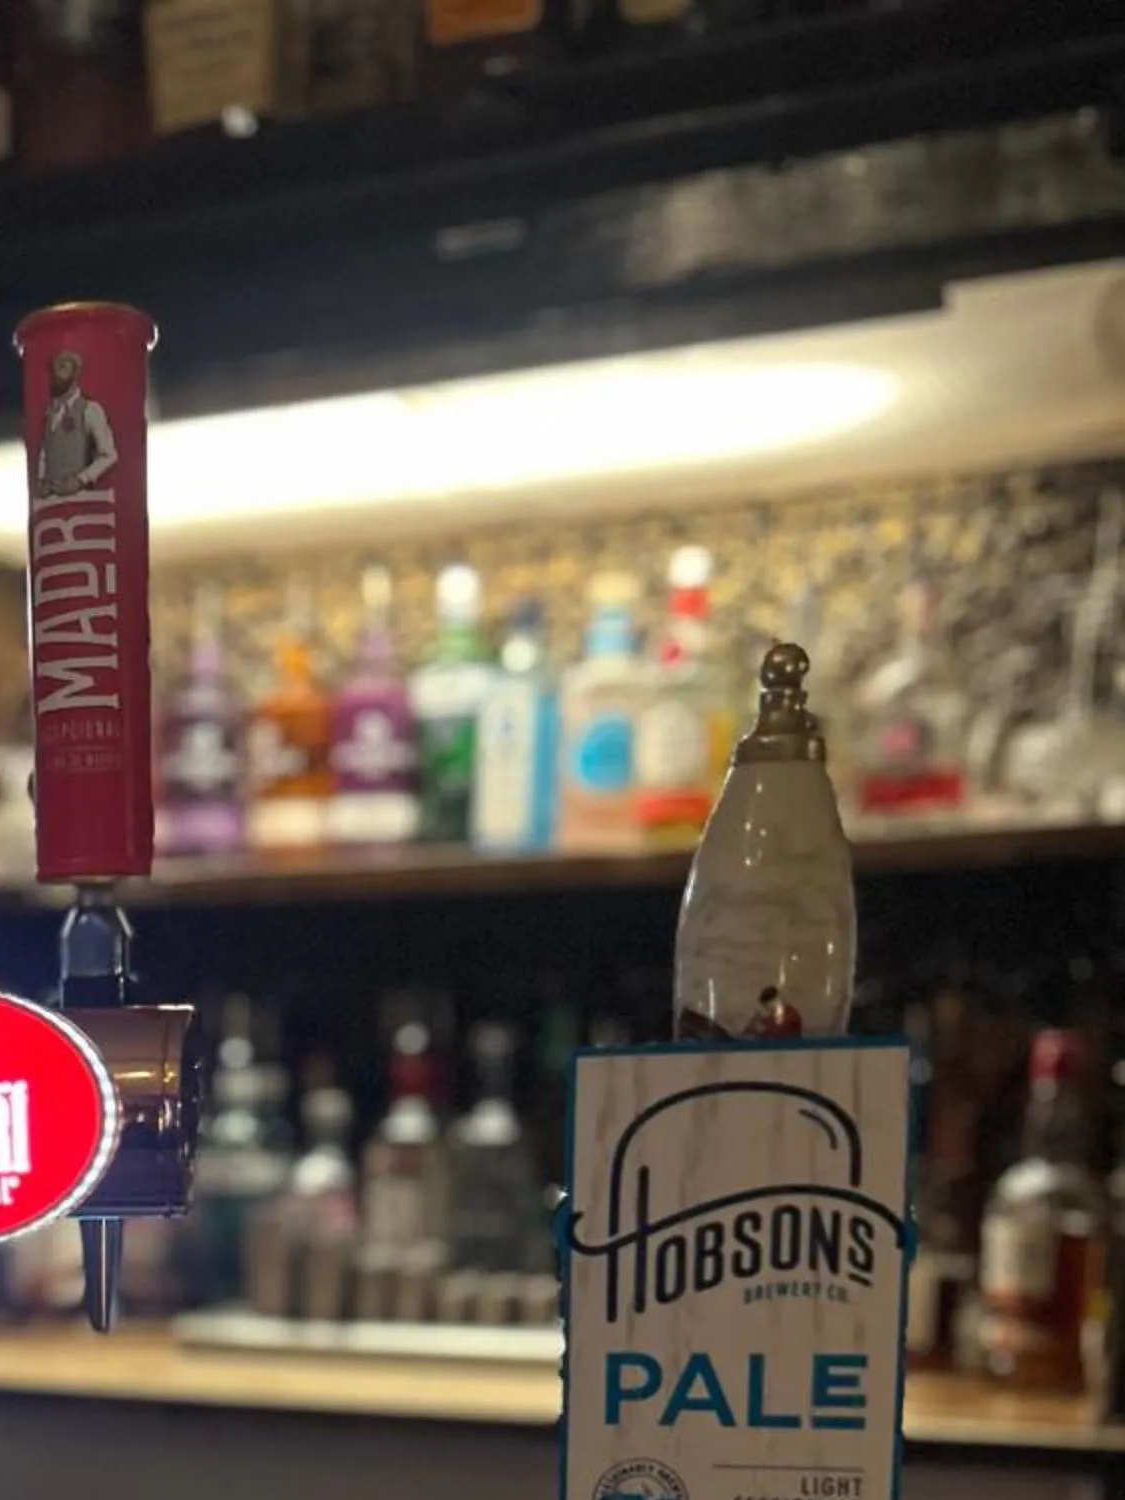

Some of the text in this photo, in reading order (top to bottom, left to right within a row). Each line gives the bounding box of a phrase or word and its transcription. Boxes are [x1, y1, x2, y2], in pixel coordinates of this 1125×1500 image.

[605, 1165, 875, 1323] HOBSONS
[604, 1352, 869, 1431] PALE
[800, 1476, 863, 1497] LIGHT
